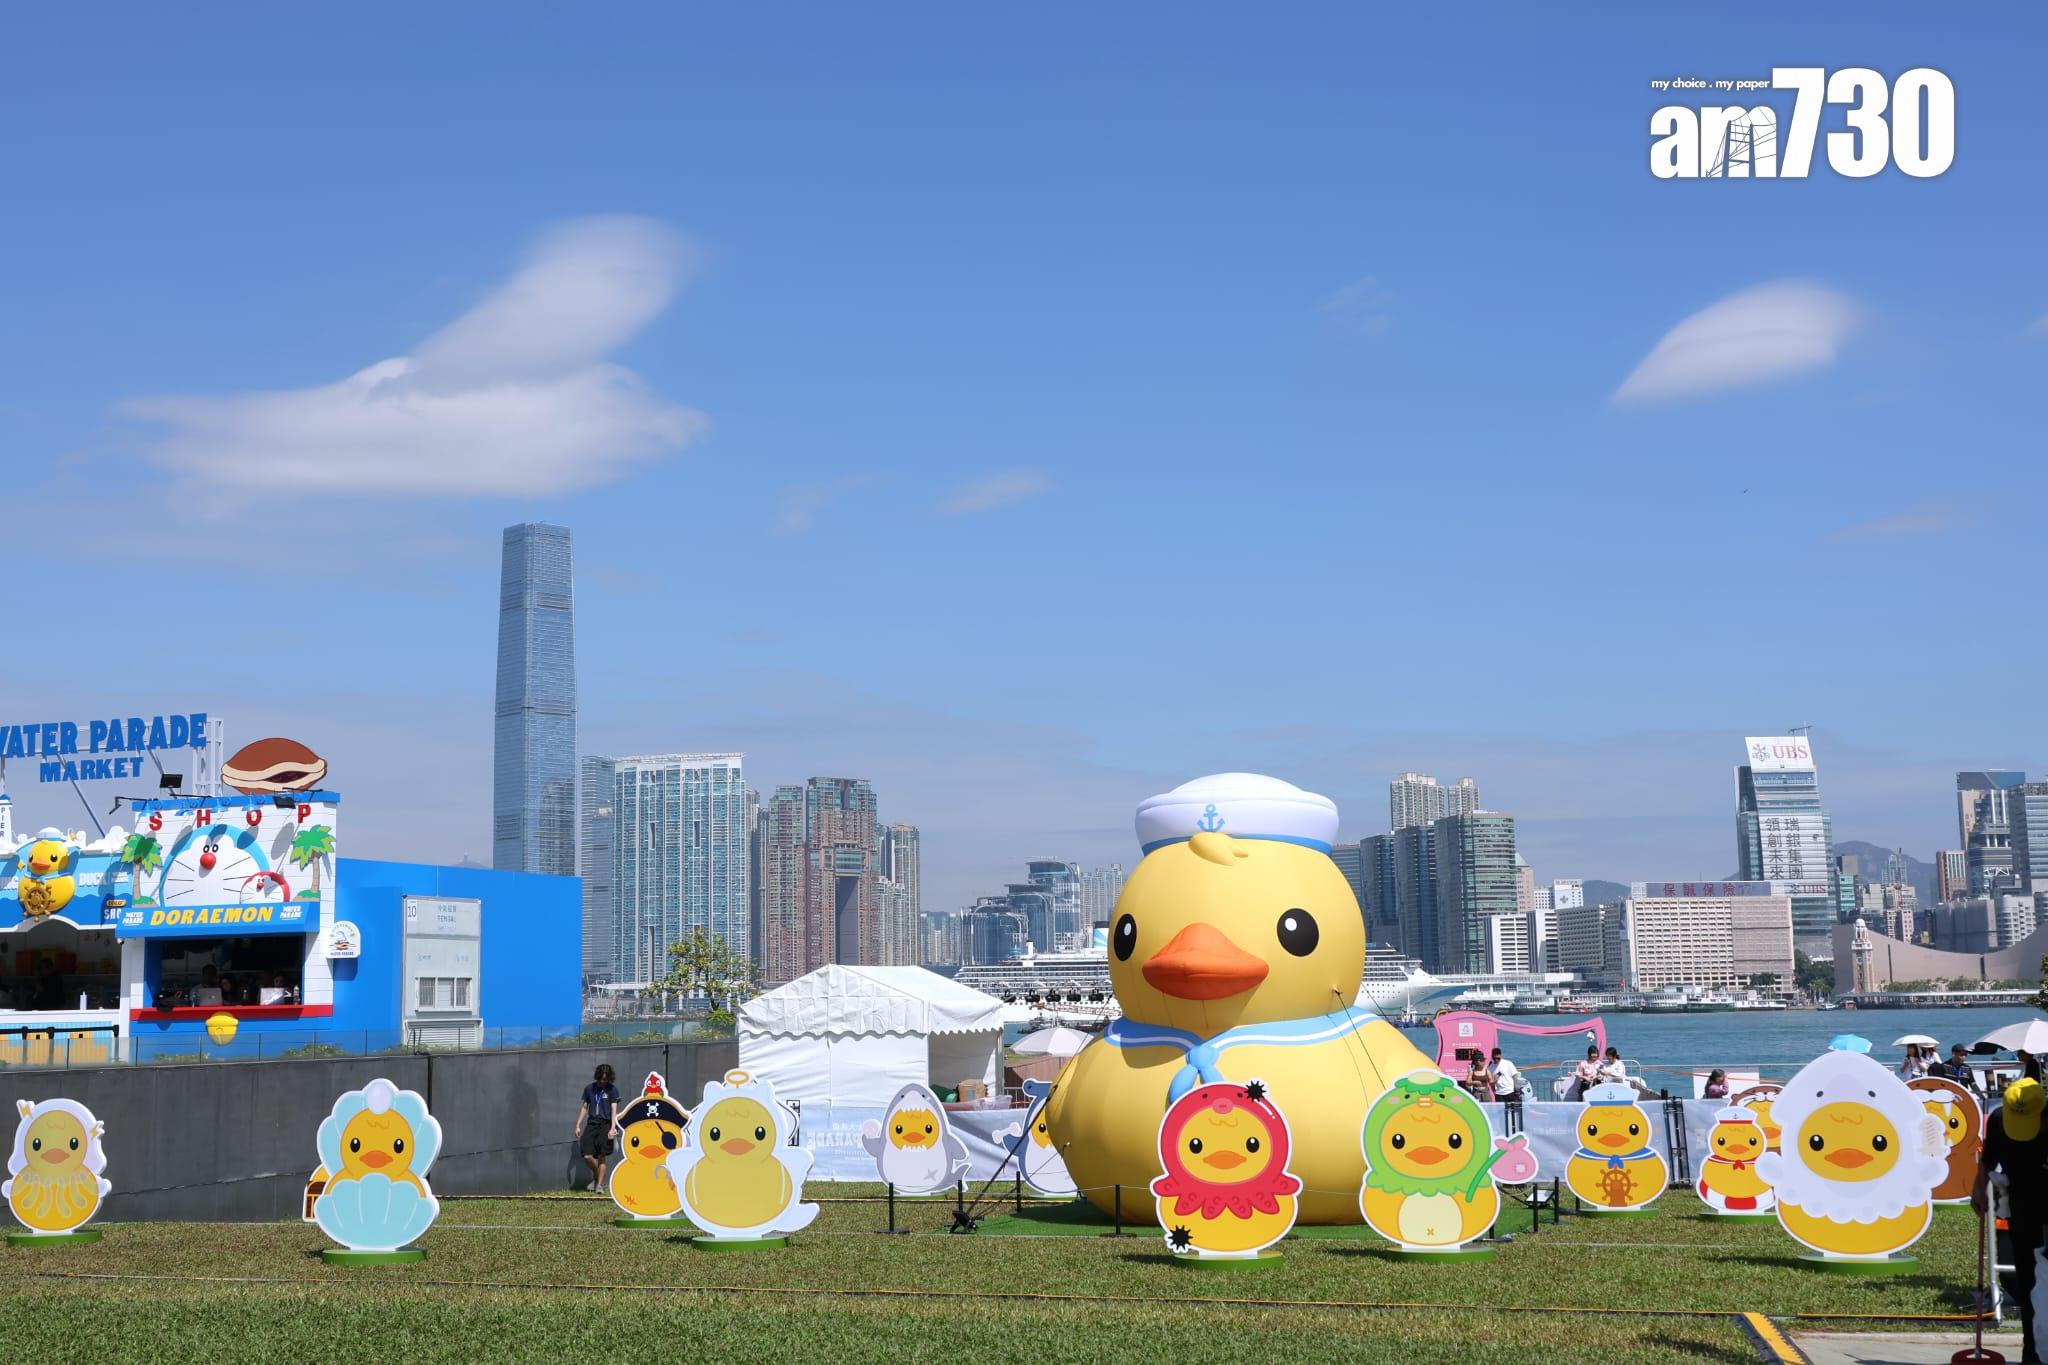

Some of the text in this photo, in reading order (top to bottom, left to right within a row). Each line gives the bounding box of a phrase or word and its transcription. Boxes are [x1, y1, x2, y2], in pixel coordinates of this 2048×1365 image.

[90, 713, 207, 753] PARADE
[1772, 745, 1808, 759] UBS
[40, 757, 144, 782] MARKET
[149, 804, 311, 831] SHOP
[1765, 817, 1784, 880] 領創未來
[1784, 817, 1803, 880] 瑞銀集團
[1663, 883, 1736, 897] 保誠保險
[1803, 884, 1826, 894] UBS
[151, 907, 273, 926] DORAEMON
